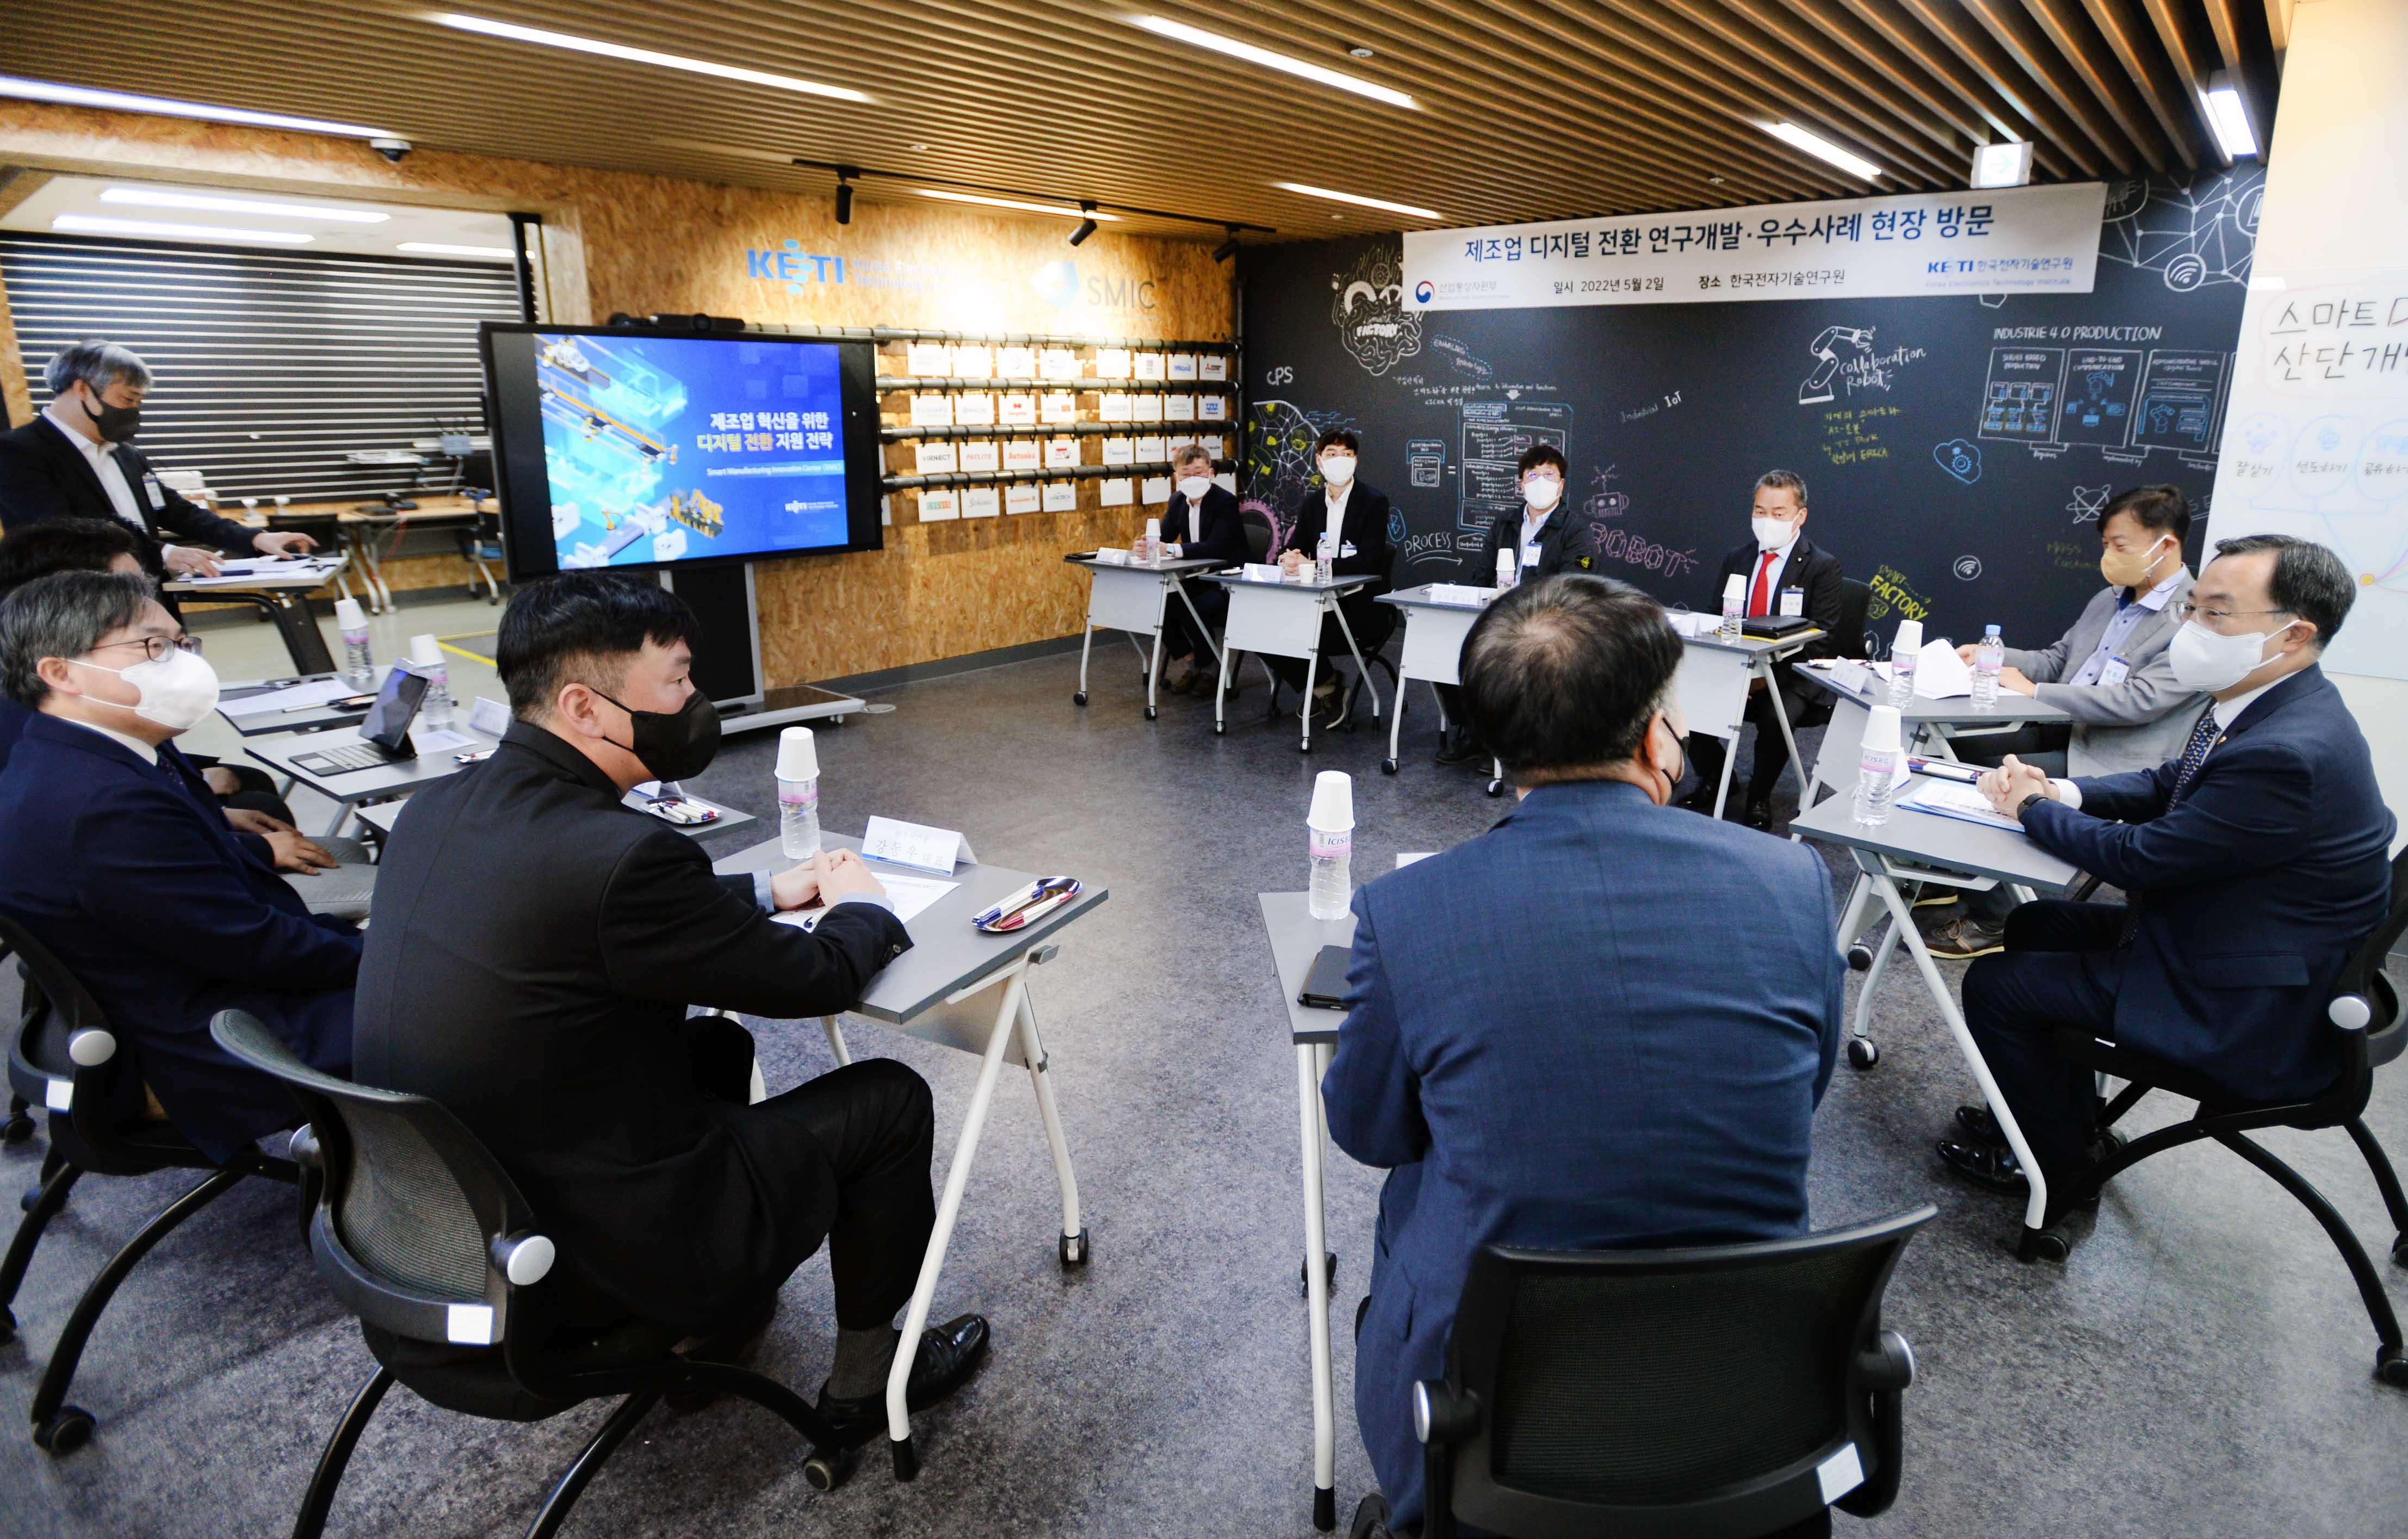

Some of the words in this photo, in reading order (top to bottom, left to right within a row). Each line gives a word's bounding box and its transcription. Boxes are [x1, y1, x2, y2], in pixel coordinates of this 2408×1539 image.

[1464, 236, 1521, 262] 제조업
[1531, 231, 1590, 259] 디지털
[1598, 227, 1642, 256] 전환
[1872, 208, 1927, 240] 현장
[1936, 205, 1995, 238] 방문
[1978, 257, 2073, 272] 한국전자기술연구원
[1553, 281, 1574, 294] 일시
[1581, 279, 1620, 293] 2022년
[1624, 277, 1642, 292] 5월
[1646, 277, 1664, 291] 2일
[1699, 274, 1721, 289] 장소
[1730, 269, 1845, 288] 한국전자기술연구원
[1088, 275, 1155, 310] SMIC
[2270, 299, 2378, 335] 스마트
[1356, 323, 1399, 338] FACTORY
[1994, 326, 2047, 340] INDUSTRIE
[2073, 326, 2163, 342] PRODUCTION
[1266, 366, 1293, 386] CPS
[1664, 390, 1682, 408] IoT
[710, 412, 755, 431] 제조업
[757, 411, 800, 430] 혁신을
[801, 411, 830, 430] 위한
[697, 433, 742, 453] 디지털
[744, 432, 773, 451] 전환
[775, 432, 804, 450] 지원
[806, 431, 834, 450] 전략
[1404, 531, 1452, 557] PROCESS
[1590, 522, 1688, 578] ROBOT
[1870, 574, 1929, 620] FACTORY
